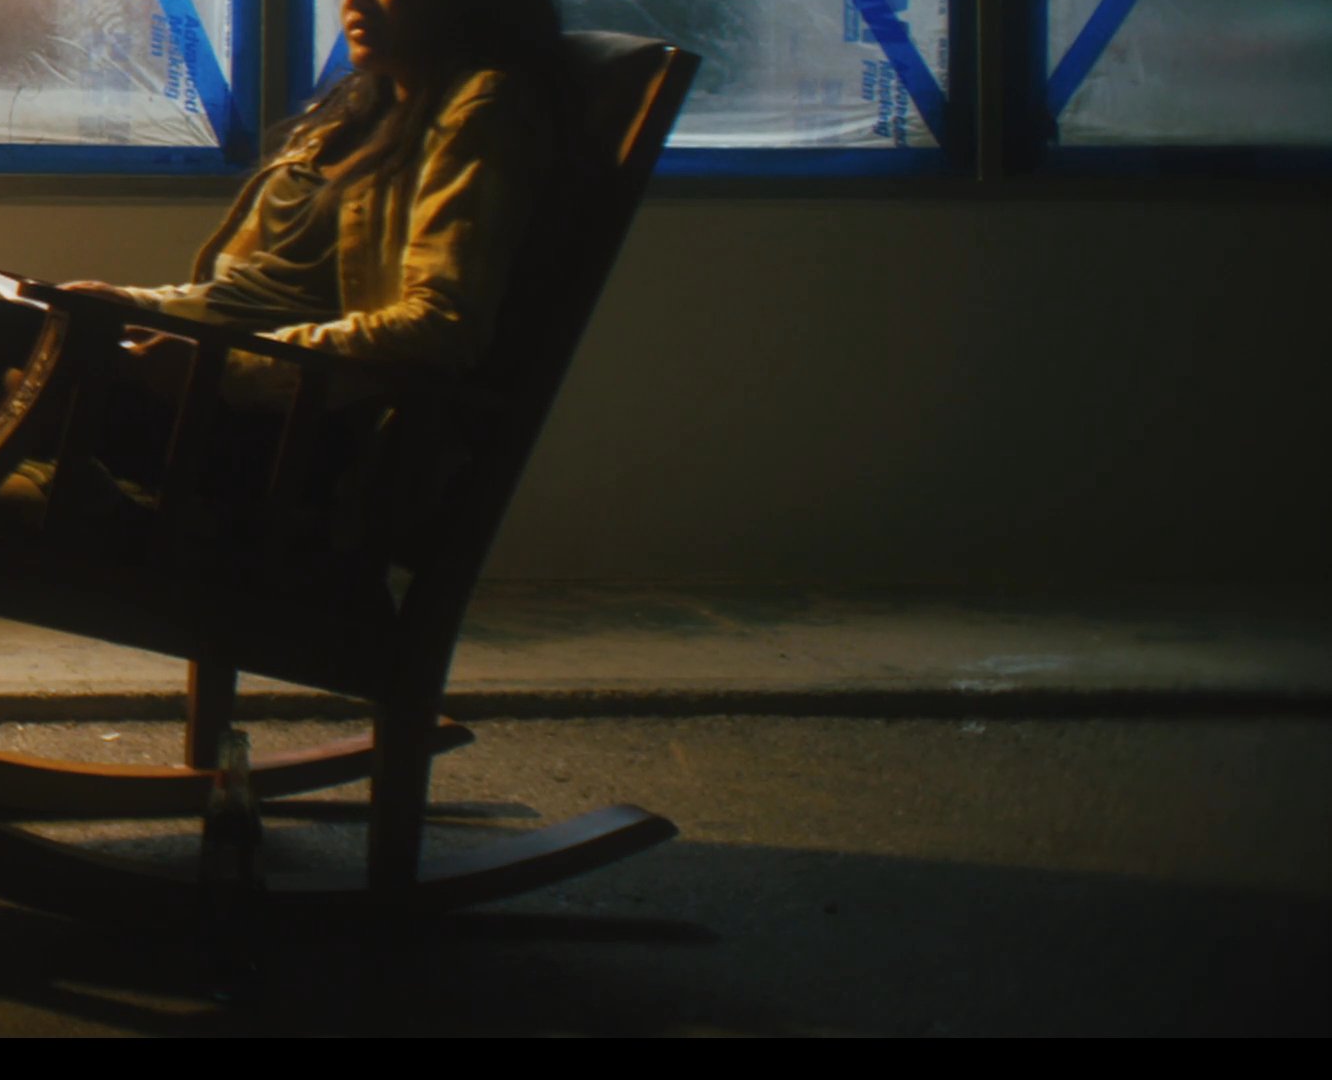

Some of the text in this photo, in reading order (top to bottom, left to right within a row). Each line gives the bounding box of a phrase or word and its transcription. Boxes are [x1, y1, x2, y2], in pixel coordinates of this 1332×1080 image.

[150, 14, 166, 58] Film
[165, 14, 184, 100] Masking
[183, 14, 201, 114] Advanced
